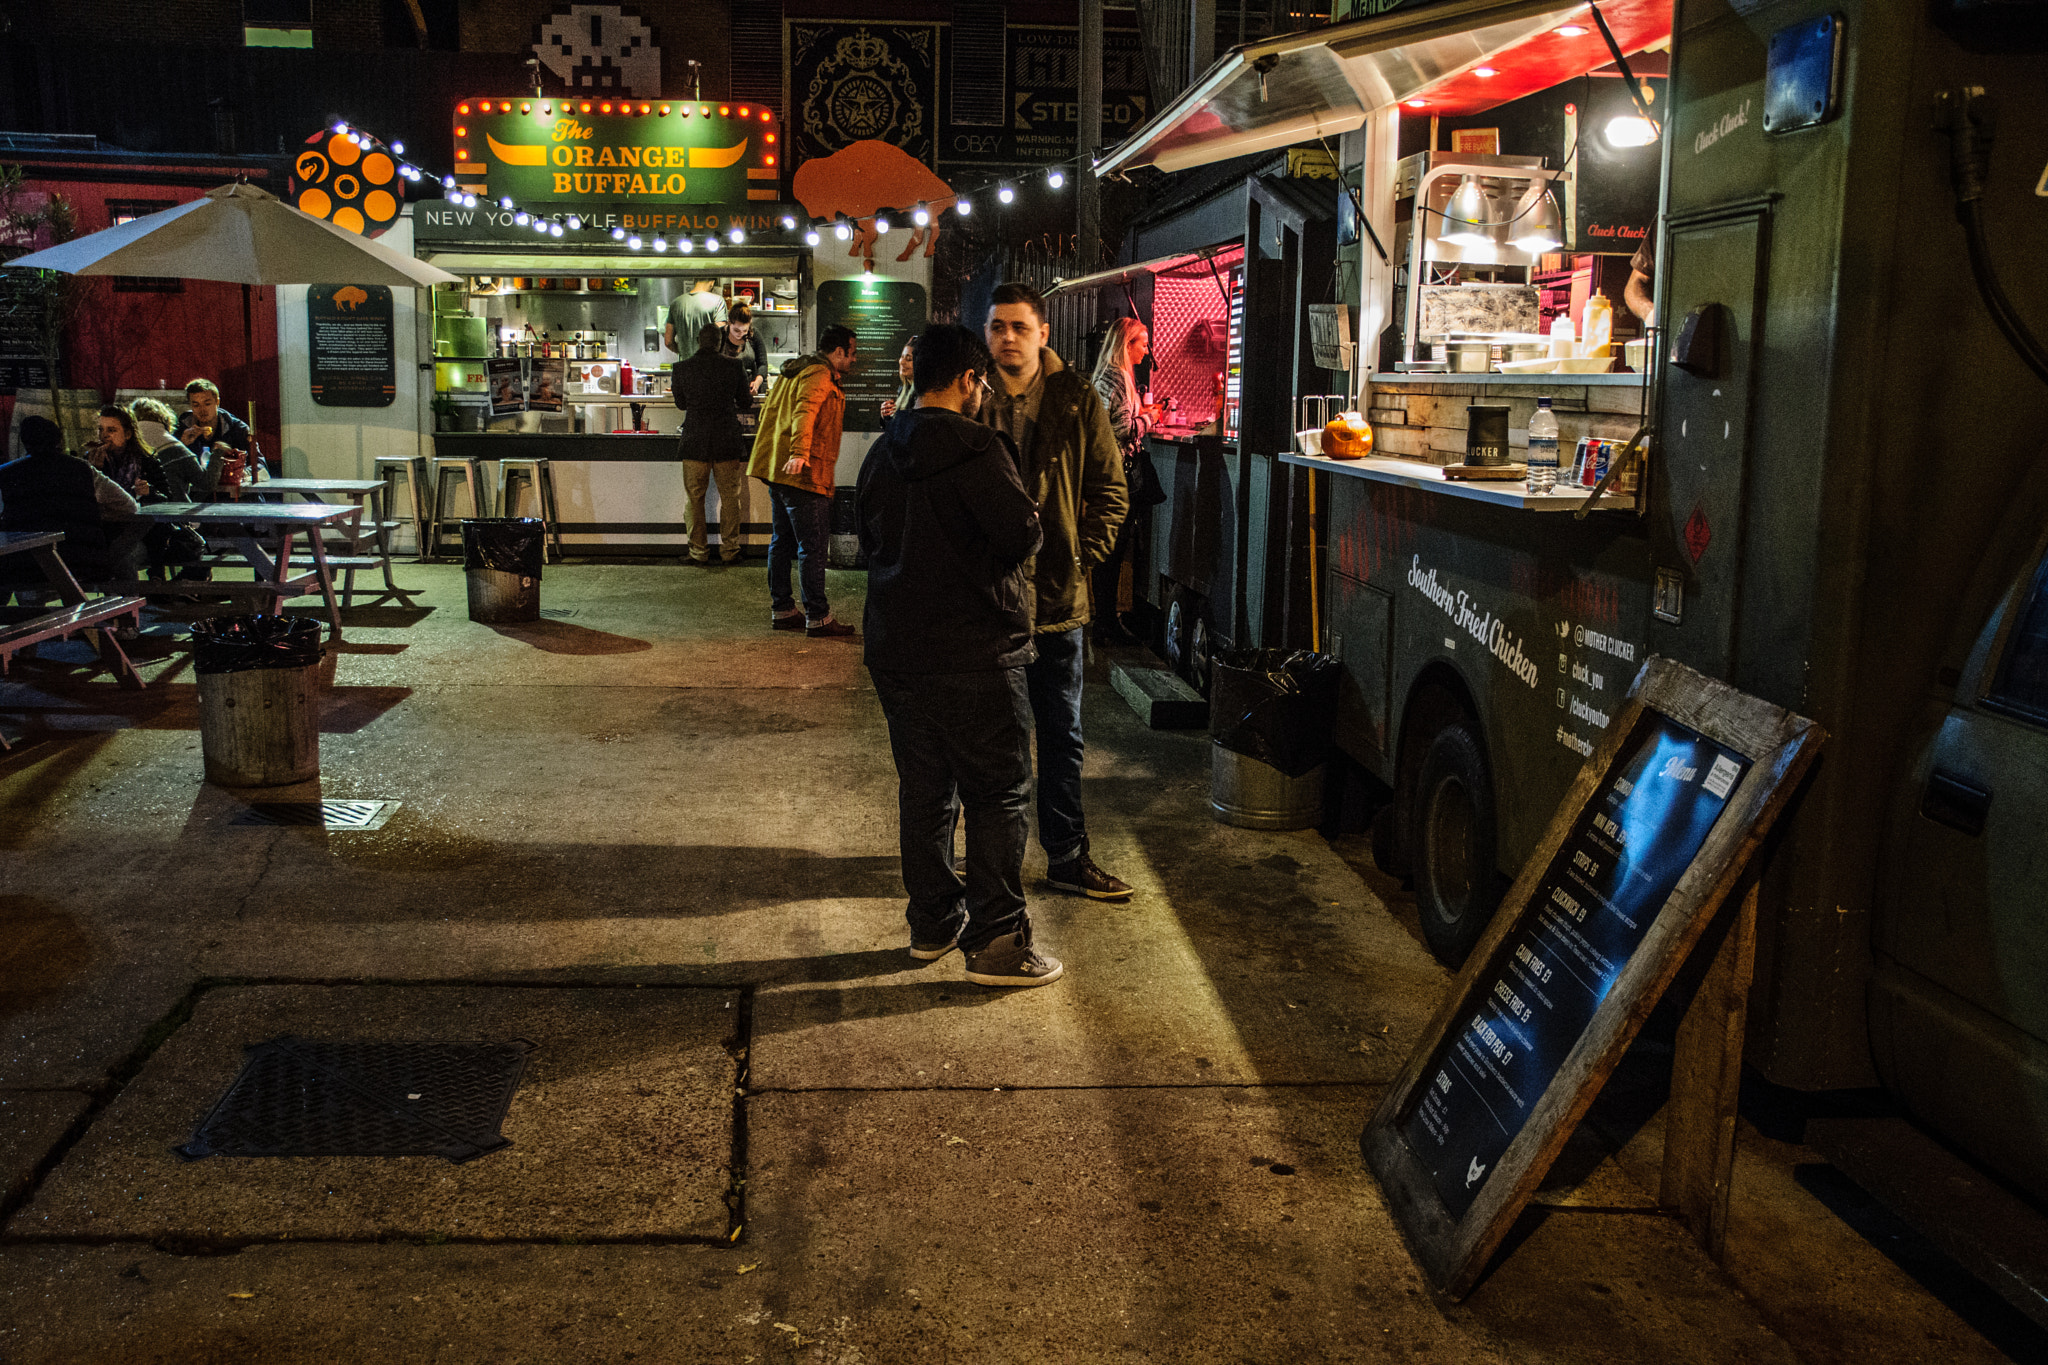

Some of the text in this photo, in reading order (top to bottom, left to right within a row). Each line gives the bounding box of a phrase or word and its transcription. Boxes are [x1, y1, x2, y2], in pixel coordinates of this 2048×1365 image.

[1032, 101, 1132, 124] STEEO
[552, 118, 594, 141] The
[953, 134, 1002, 153] OBEY
[1016, 147, 1070, 157] INFERIOR
[552, 146, 684, 168] ORANGE
[553, 173, 686, 194] BUFFALO
[426, 211, 474, 226] NEW
[623, 214, 719, 229] BUFFALO
[1587, 224, 1615, 238] Cluck
[1407, 553, 1455, 617] Southern
[1454, 590, 1491, 645] Fried
[1489, 618, 1539, 688] Chicken
[1607, 637, 1634, 662] CLUCKER
[1572, 660, 1604, 690] cluck_you
[1658, 757, 1697, 781] Menu
[1572, 851, 1591, 871] STRIPS
[1552, 887, 1579, 915] CLUCKWICH
[1516, 944, 1551, 983] CAJUN FRIES £3
[1494, 980, 1530, 1022] CHEESE FRIES £5
[1472, 1014, 1487, 1036] BLACK
[1491, 1038, 1504, 1057] PEAS
[1436, 1070, 1451, 1093] EXTRAS
